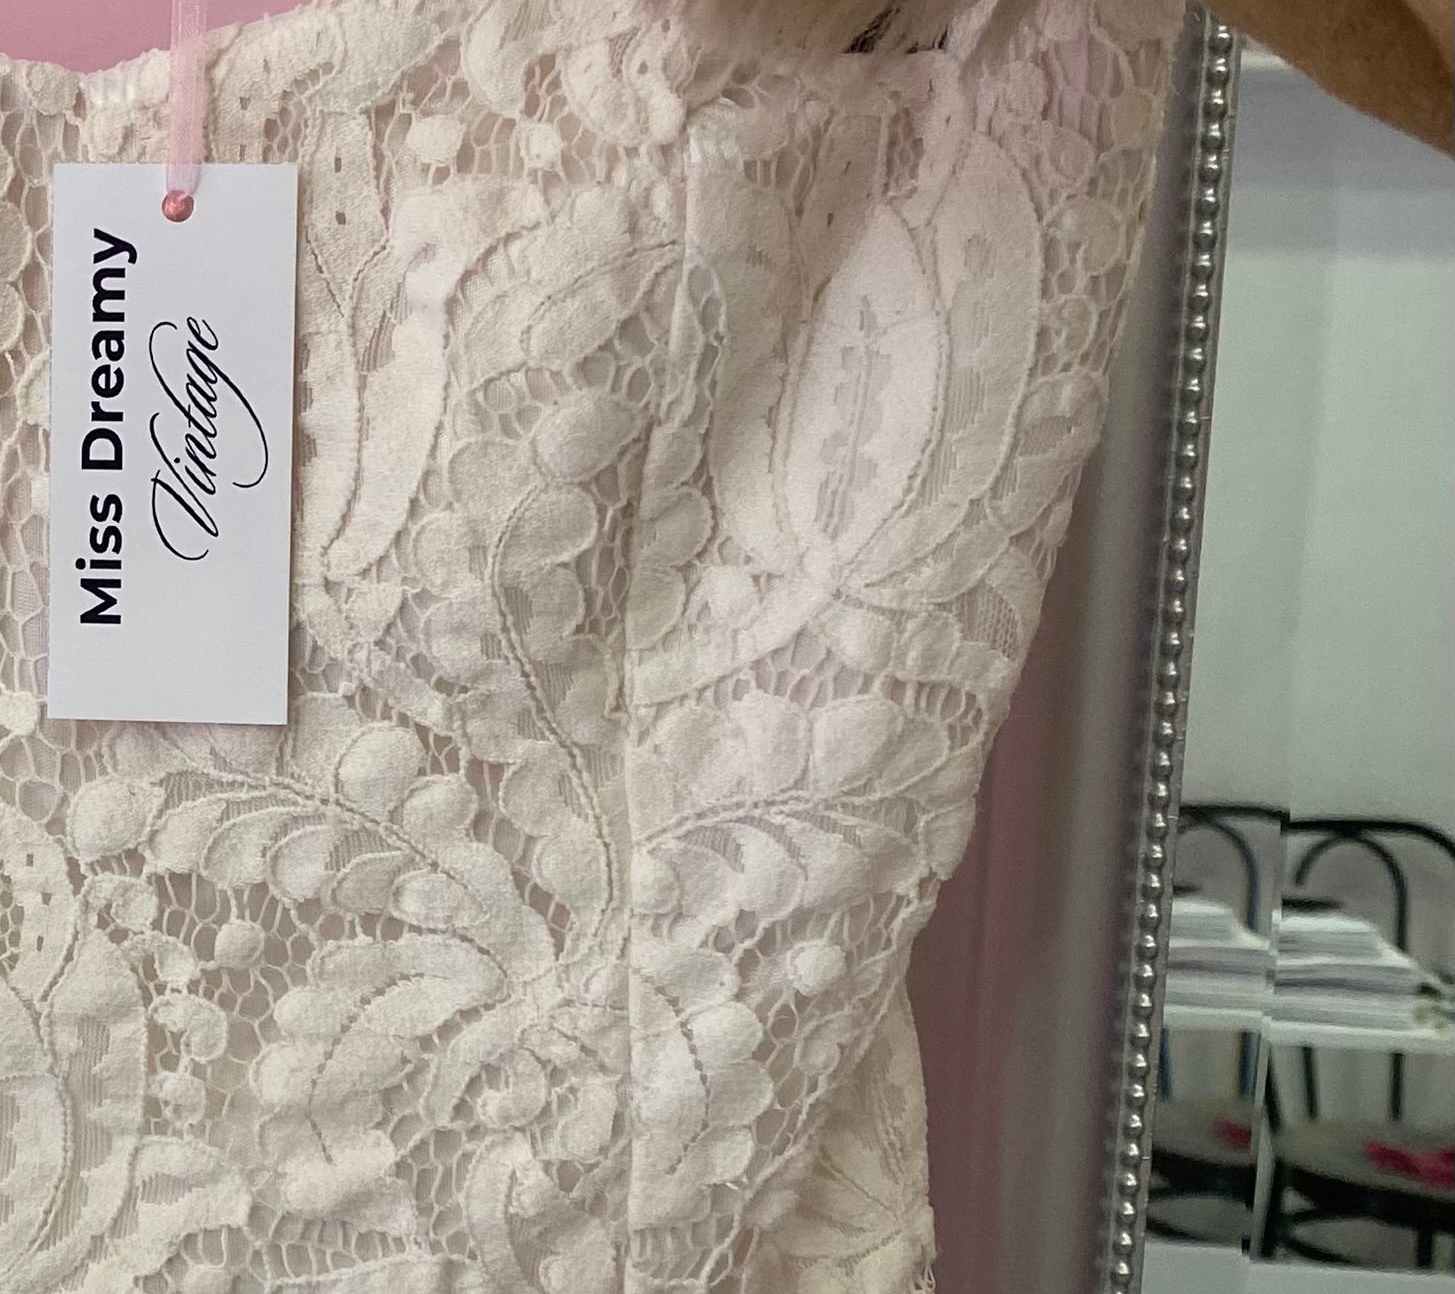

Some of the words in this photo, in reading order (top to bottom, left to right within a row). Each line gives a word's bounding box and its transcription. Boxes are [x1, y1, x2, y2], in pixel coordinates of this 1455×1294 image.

[81, 228, 138, 471] Dreamy
[148, 316, 269, 562] Vintage
[75, 493, 123, 625] Miss
